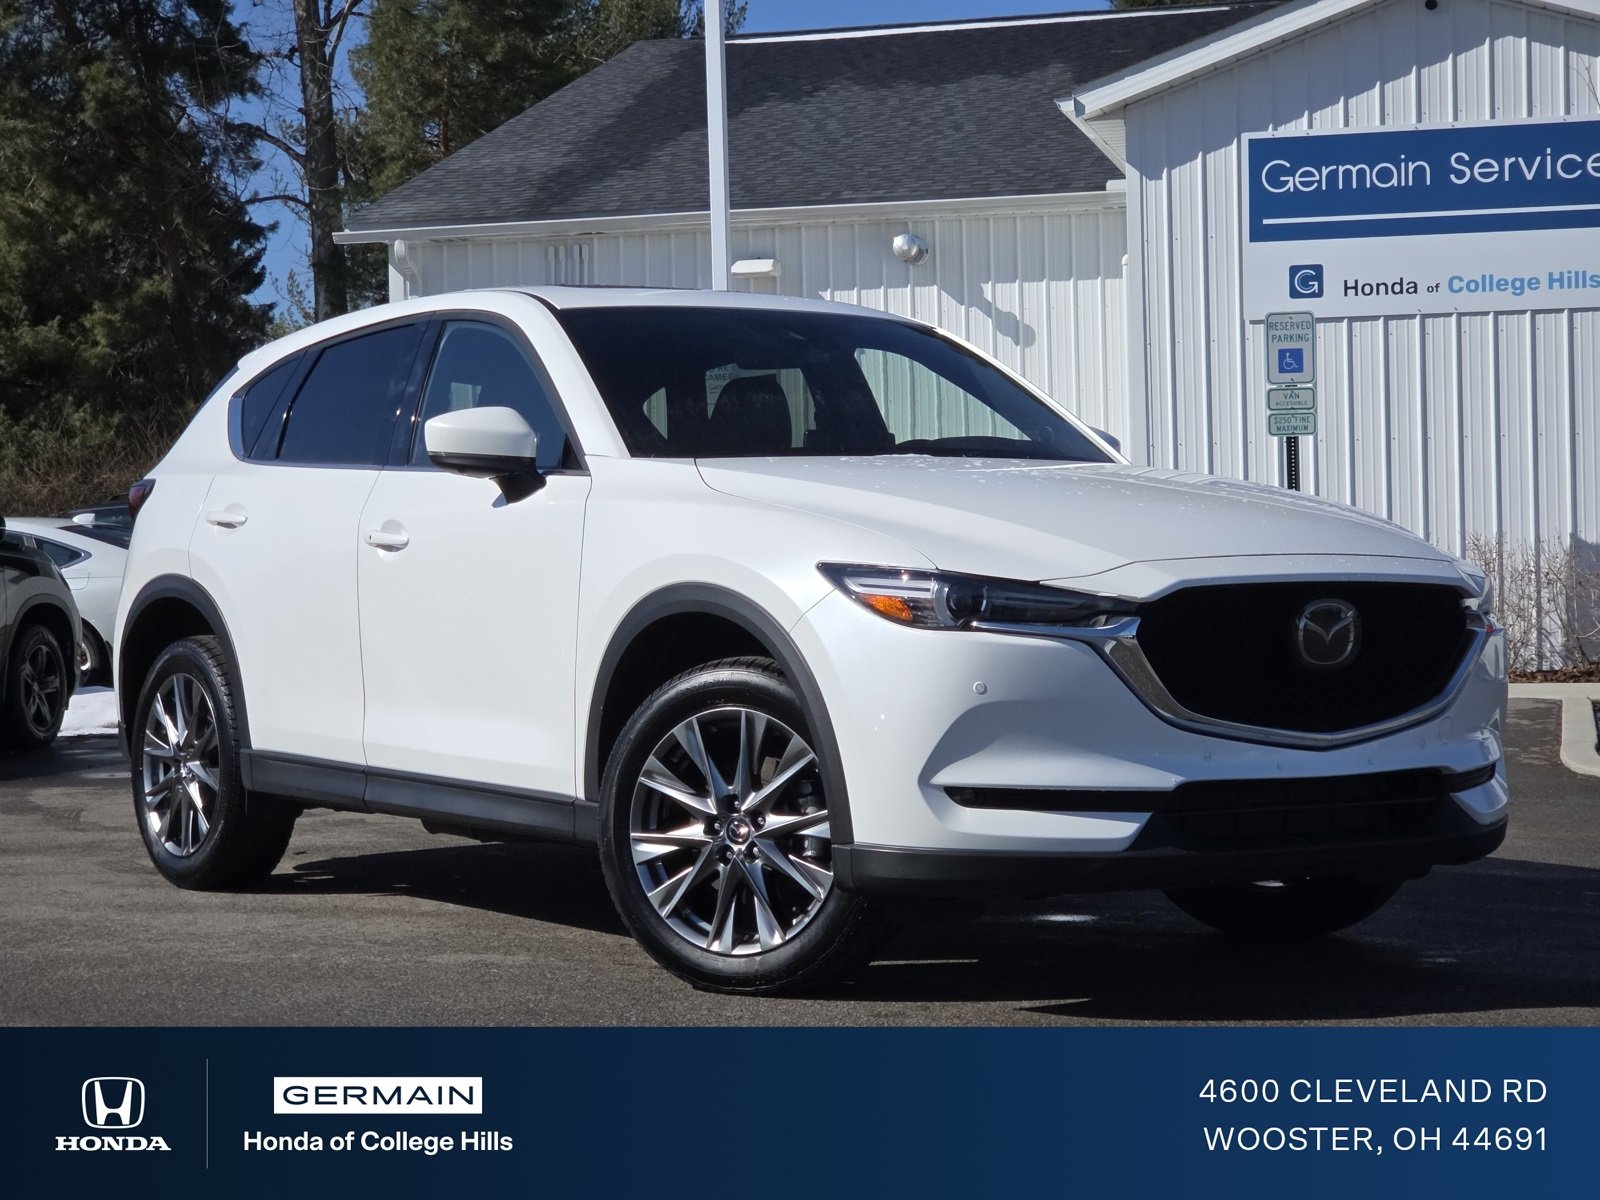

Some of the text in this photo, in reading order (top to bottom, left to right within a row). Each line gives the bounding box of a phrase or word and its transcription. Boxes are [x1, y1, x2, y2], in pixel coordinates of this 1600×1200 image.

[1261, 147, 1600, 193] Germain Service
[1343, 270, 1600, 297] Honda of College Hills
[1269, 320, 1311, 331] RESERVED
[1271, 334, 1310, 343] PARKING
[1284, 392, 1300, 400] VAN
[1273, 416, 1311, 425] $250 FINE
[1276, 424, 1309, 432] MAXIMUM
